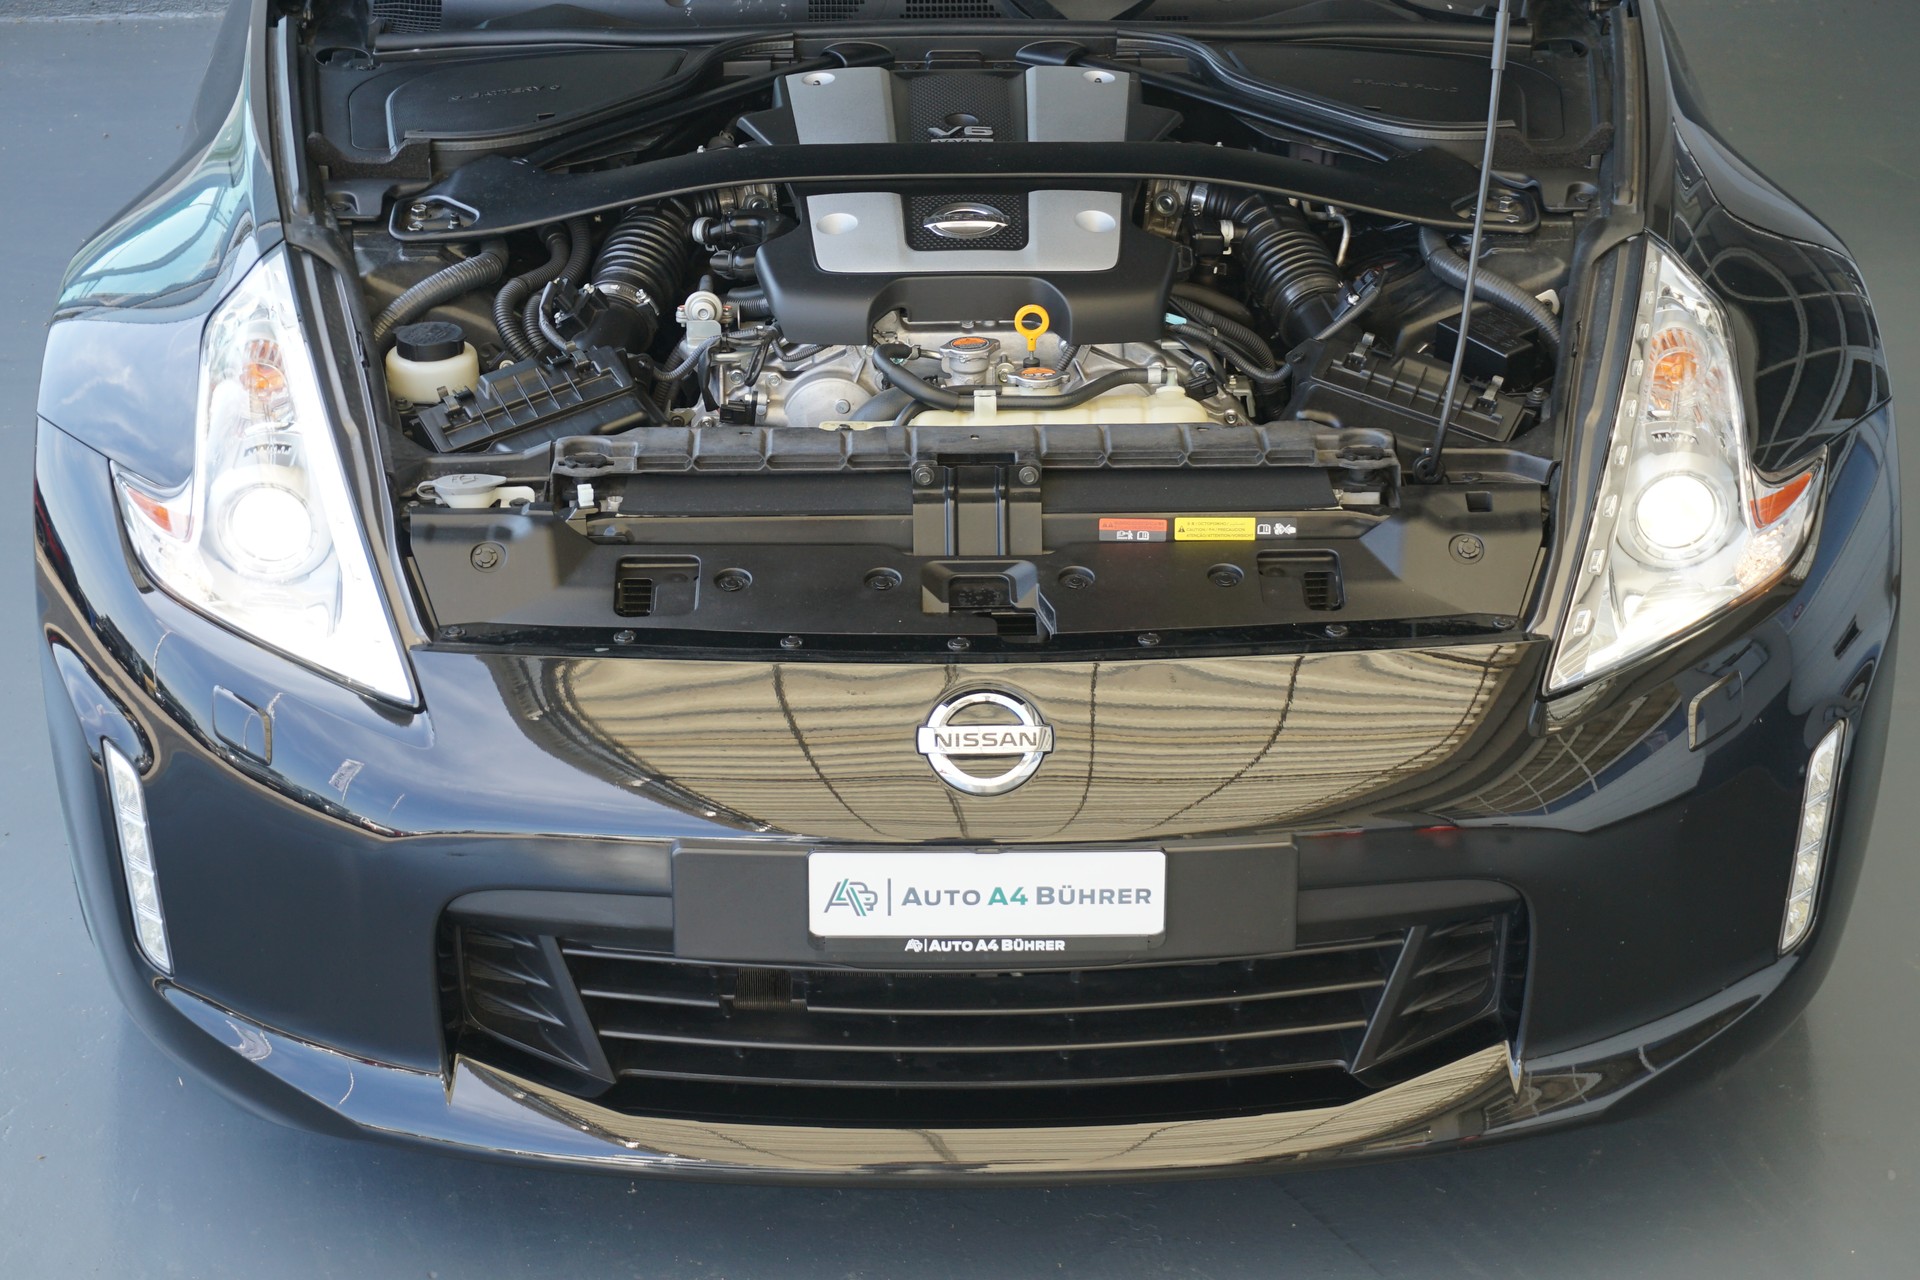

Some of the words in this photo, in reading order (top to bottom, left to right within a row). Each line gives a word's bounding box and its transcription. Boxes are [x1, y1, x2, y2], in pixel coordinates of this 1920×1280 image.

[927, 125, 994, 137] V6
[934, 732, 1037, 748] NISSAN
[901, 886, 981, 906] AUTO
[987, 886, 1029, 906] A4
[1036, 884, 1152, 906] BÜHRER
[929, 939, 974, 952] AUTO
[975, 938, 1000, 952] A4
[1001, 938, 1066, 952] BÜHRER
